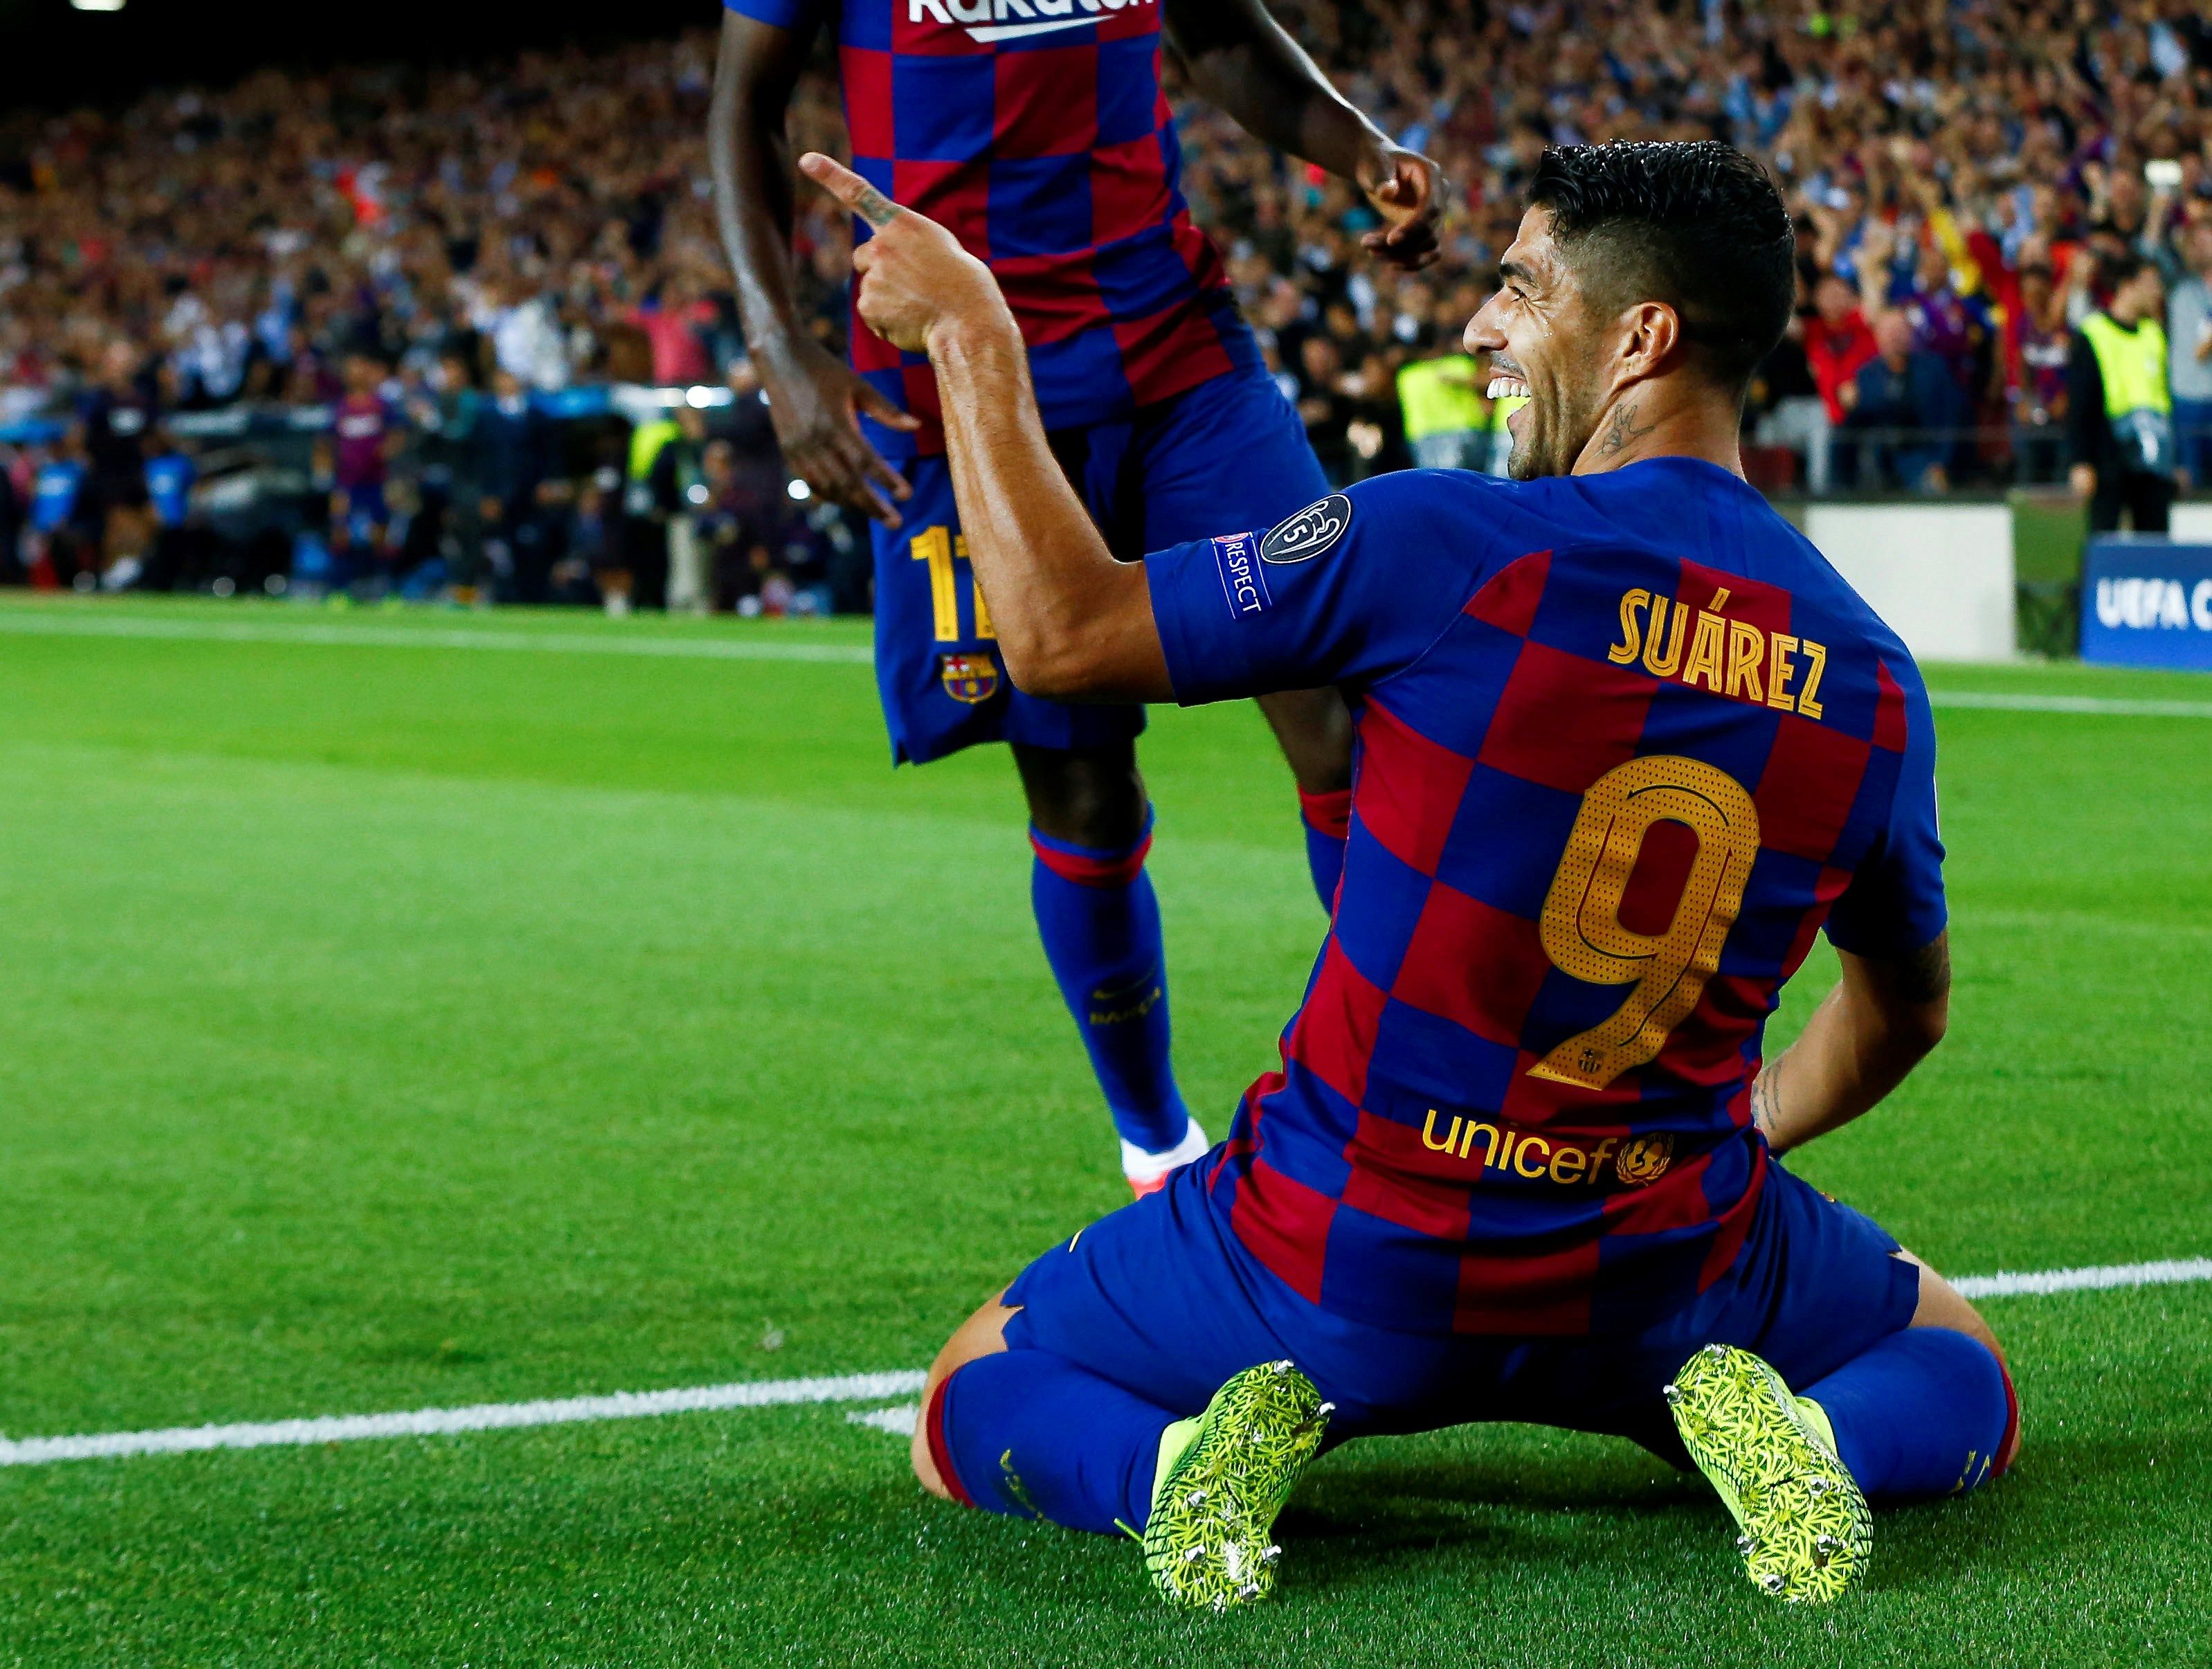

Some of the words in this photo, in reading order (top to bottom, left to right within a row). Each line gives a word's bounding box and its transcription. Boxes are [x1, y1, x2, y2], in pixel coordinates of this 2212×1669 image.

[1283, 524, 1308, 543] 5
[1224, 541, 1262, 612] RESPECT
[2096, 577, 2190, 630] UEFA
[1608, 586, 1827, 720] SUÁREZ
[1525, 754, 1761, 1091] 9
[1422, 1108, 1617, 1184] unicef
